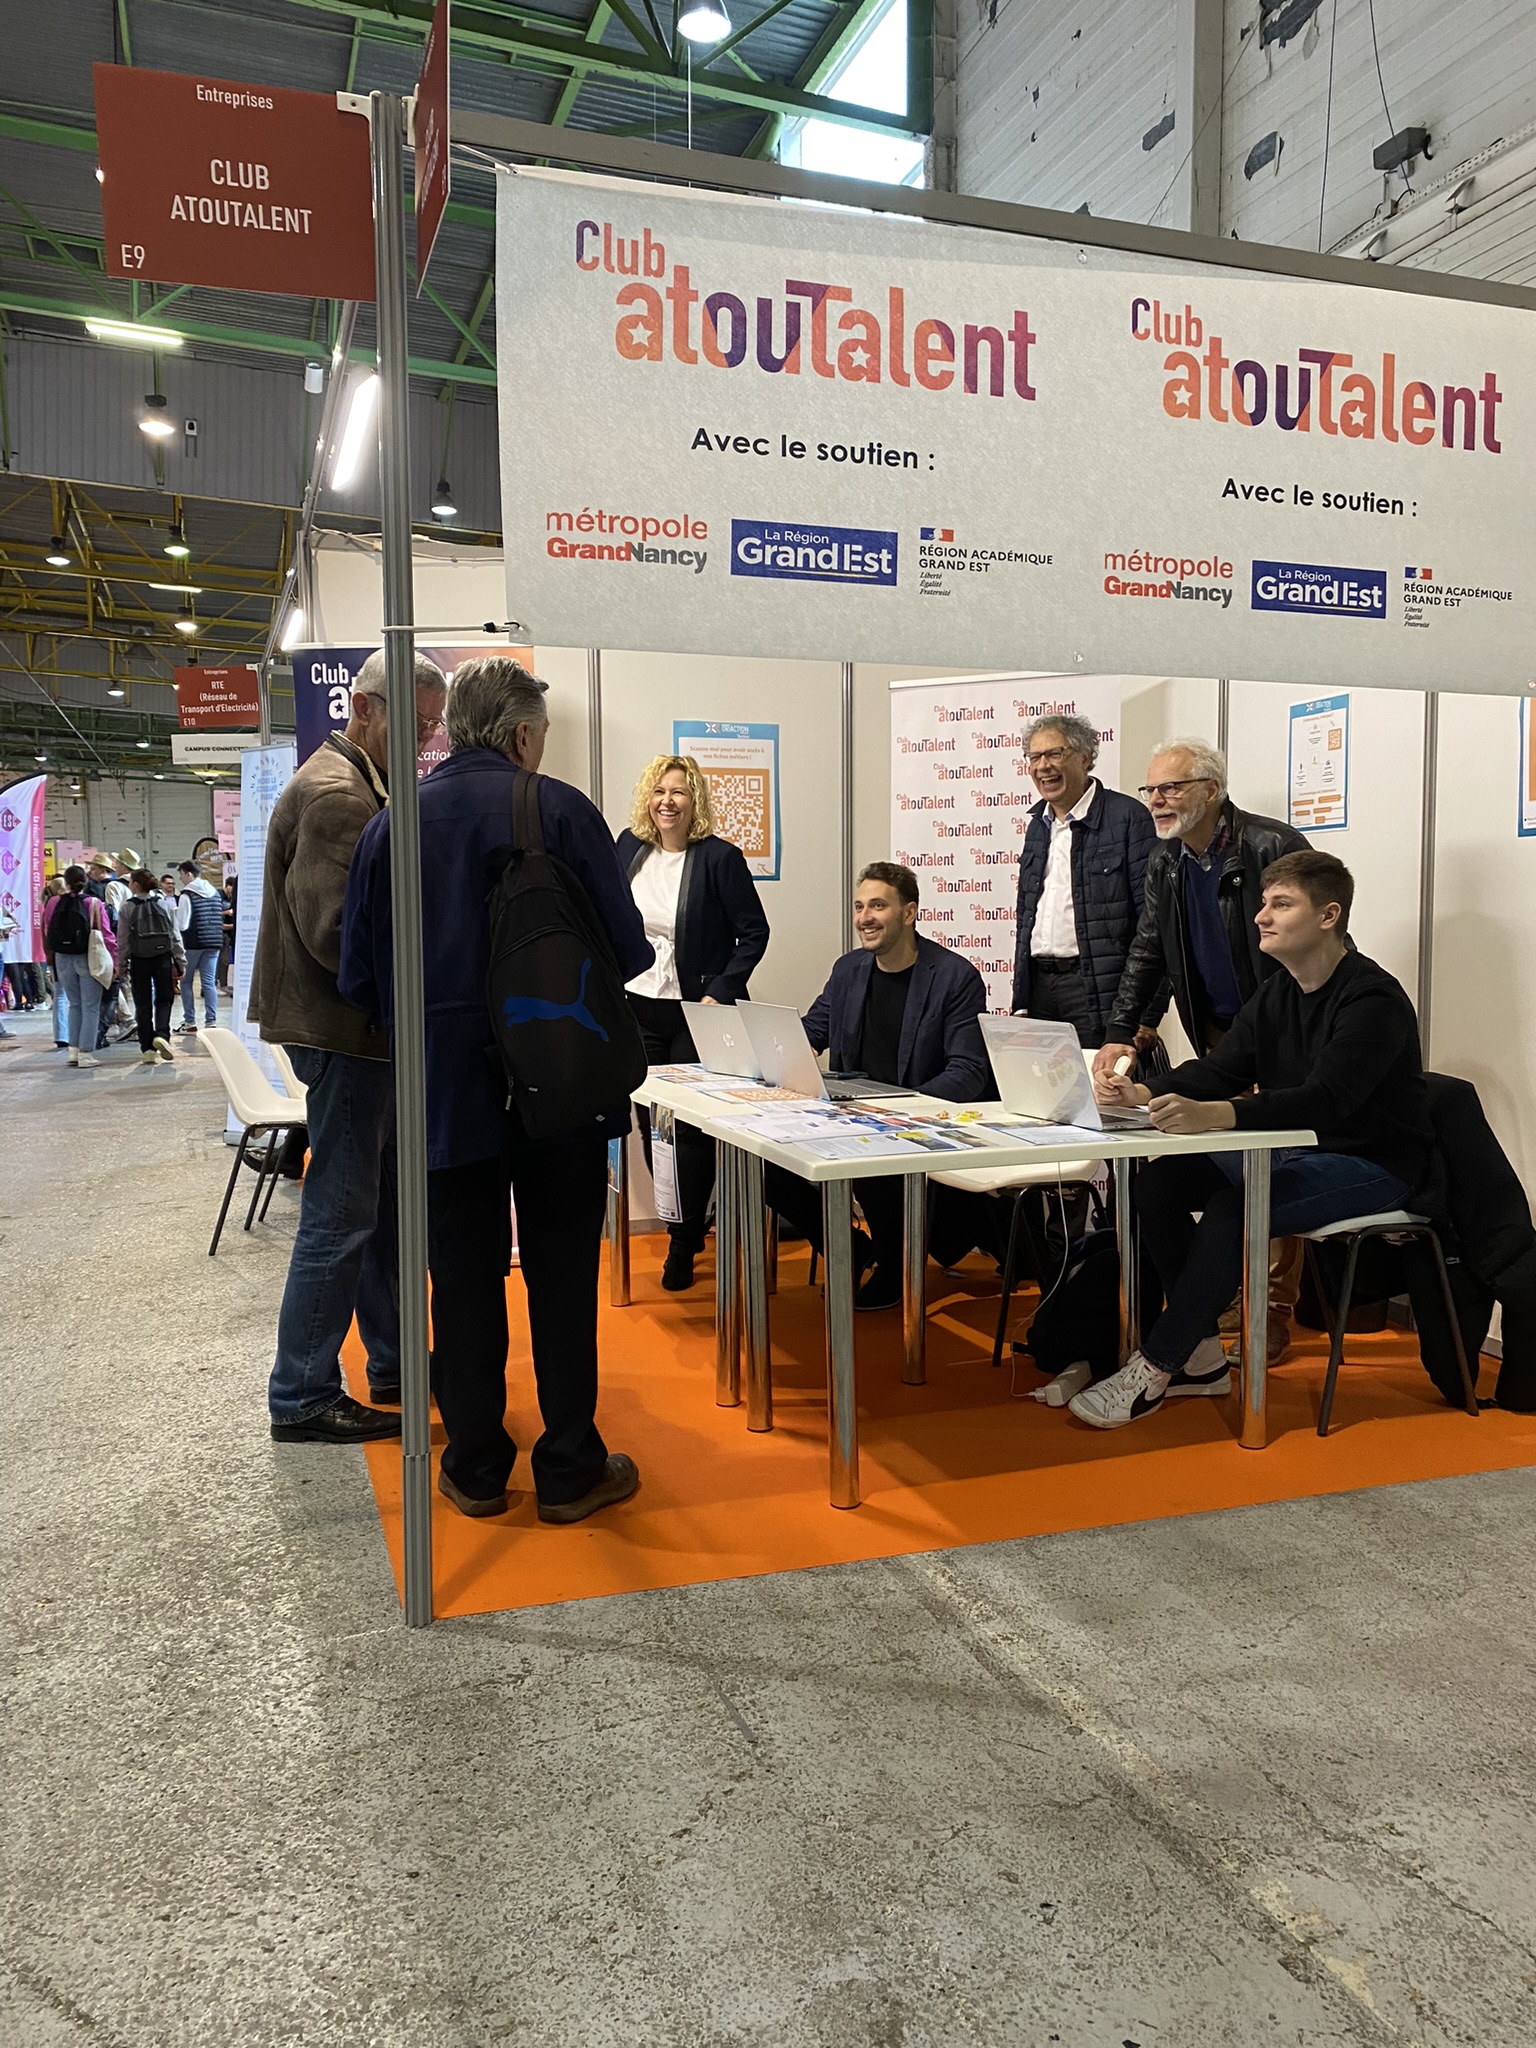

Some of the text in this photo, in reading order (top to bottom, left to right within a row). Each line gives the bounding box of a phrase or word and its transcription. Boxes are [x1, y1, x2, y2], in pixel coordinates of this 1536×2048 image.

[196, 84, 273, 110] Entreprises
[210, 158, 270, 190] CLUB
[170, 194, 312, 235] ATOUTALENT
[121, 243, 145, 269] E9
[575, 219, 666, 278] Club
[1131, 297, 1203, 348] Club
[615, 264, 1037, 401] atouTalent
[1162, 336, 1503, 454] atouTalent
[690, 427, 770, 458] Avec
[781, 435, 806, 459] le
[816, 440, 919, 470] soutien
[1221, 477, 1285, 505] Avec
[1293, 484, 1314, 507] le
[1322, 489, 1405, 516] soutien
[546, 507, 708, 542] métropole
[764, 529, 829, 545] La Région
[919, 544, 1053, 566] RÉGION ACADÉMIQUE
[919, 558, 991, 573] GRAND EST
[1104, 549, 1233, 581] métropole
[919, 572, 942, 580] Liberté
[1278, 569, 1331, 583] La Région
[1404, 582, 1513, 601] RÉGION ACADÉMIQUE
[1403, 594, 1462, 608] GRAND EST
[311, 663, 349, 685] Club
[211, 681, 225, 690] RTE
[199, 692, 238, 703] (Réseau de
[180, 705, 215, 715] Transport
[938, 706, 995, 723] atouTalent
[1017, 700, 1076, 718] atouTalent
[183, 717, 196, 727] E10
[901, 737, 956, 754] atouTalent
[938, 764, 994, 780] atouTalent
[900, 796, 955, 811] atouTalent
[975, 792, 1032, 808] atouTalent
[937, 823, 993, 838] atouTalent
[900, 853, 955, 867] atouTalent
[937, 878, 993, 893] atouTalent
[937, 934, 992, 948] atouTalent
